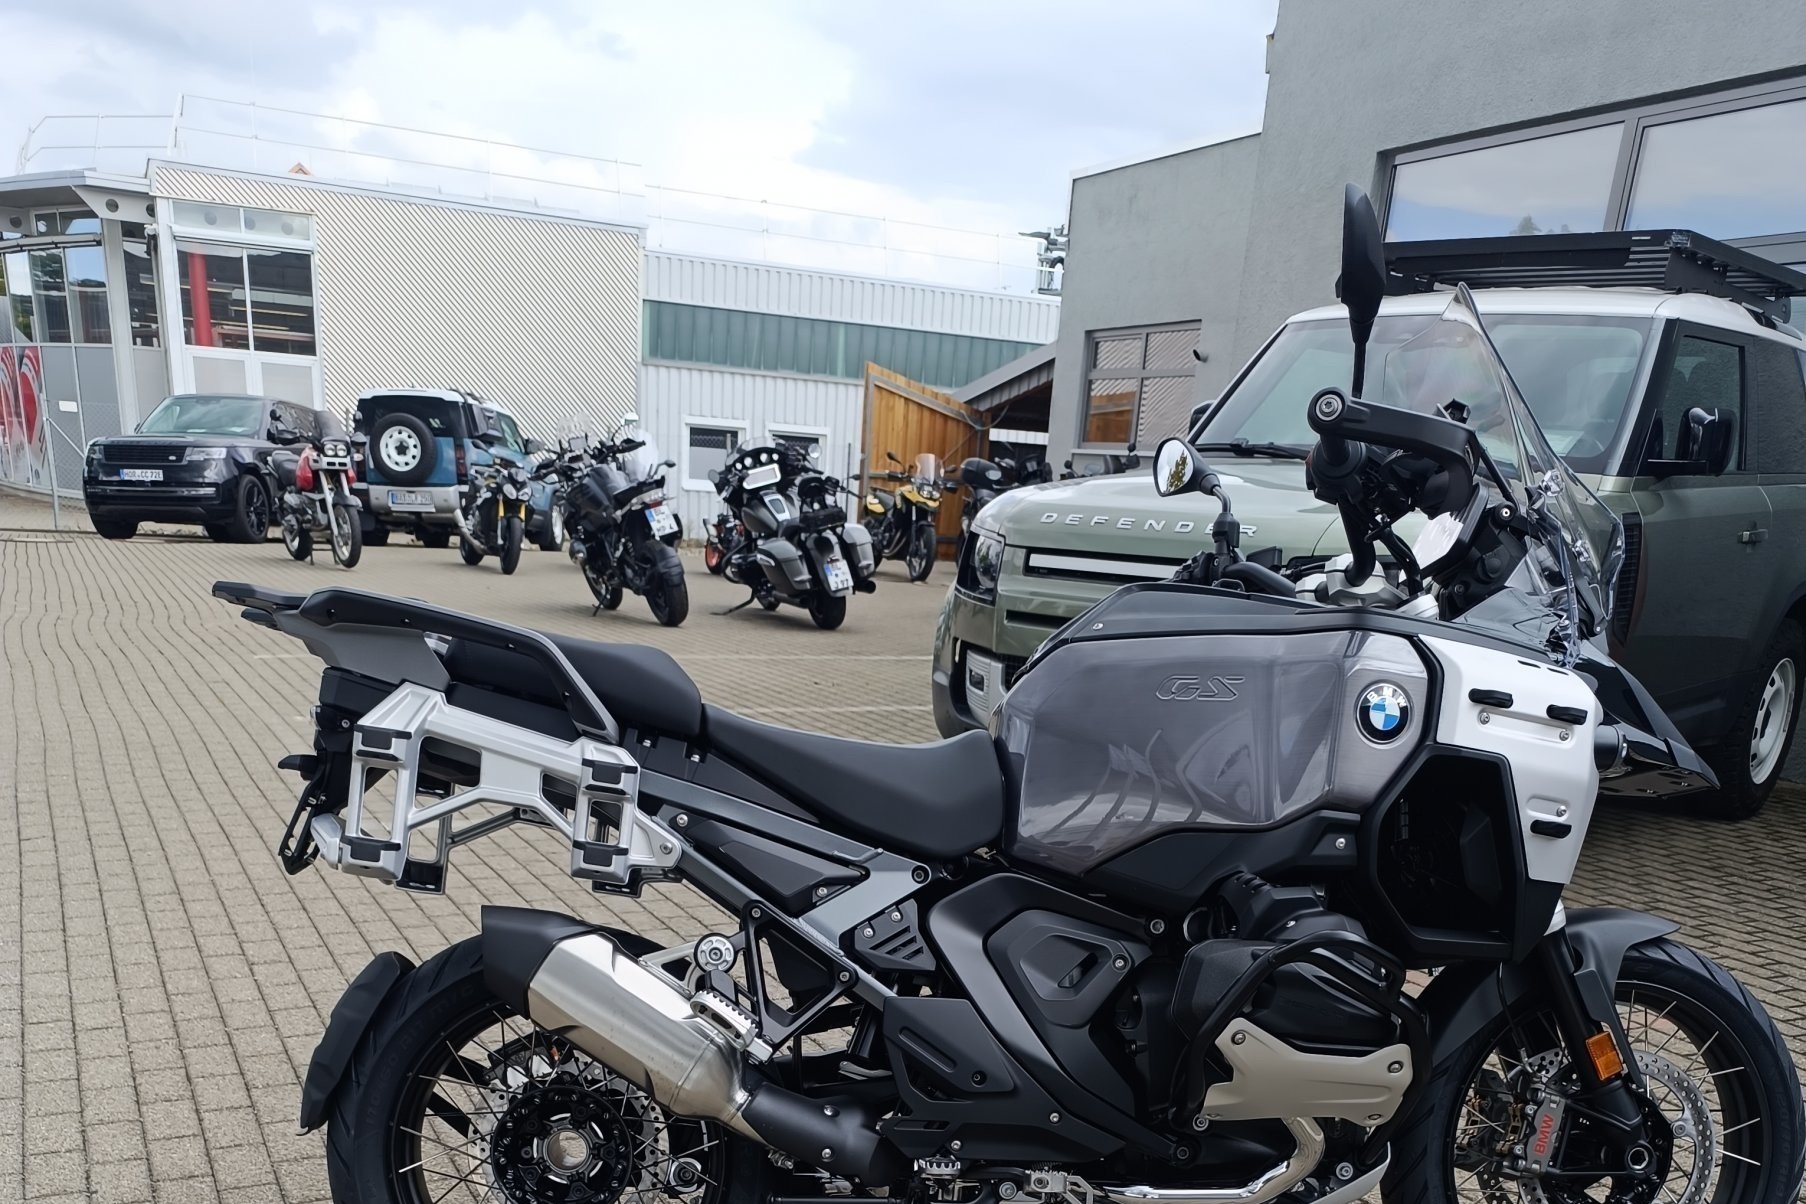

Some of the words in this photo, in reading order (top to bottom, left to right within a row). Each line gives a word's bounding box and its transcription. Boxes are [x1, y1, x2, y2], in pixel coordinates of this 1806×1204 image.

[1156, 675, 1246, 701] GS
[1367, 686, 1407, 708] BMW
[1534, 1113, 1554, 1154] BMW
